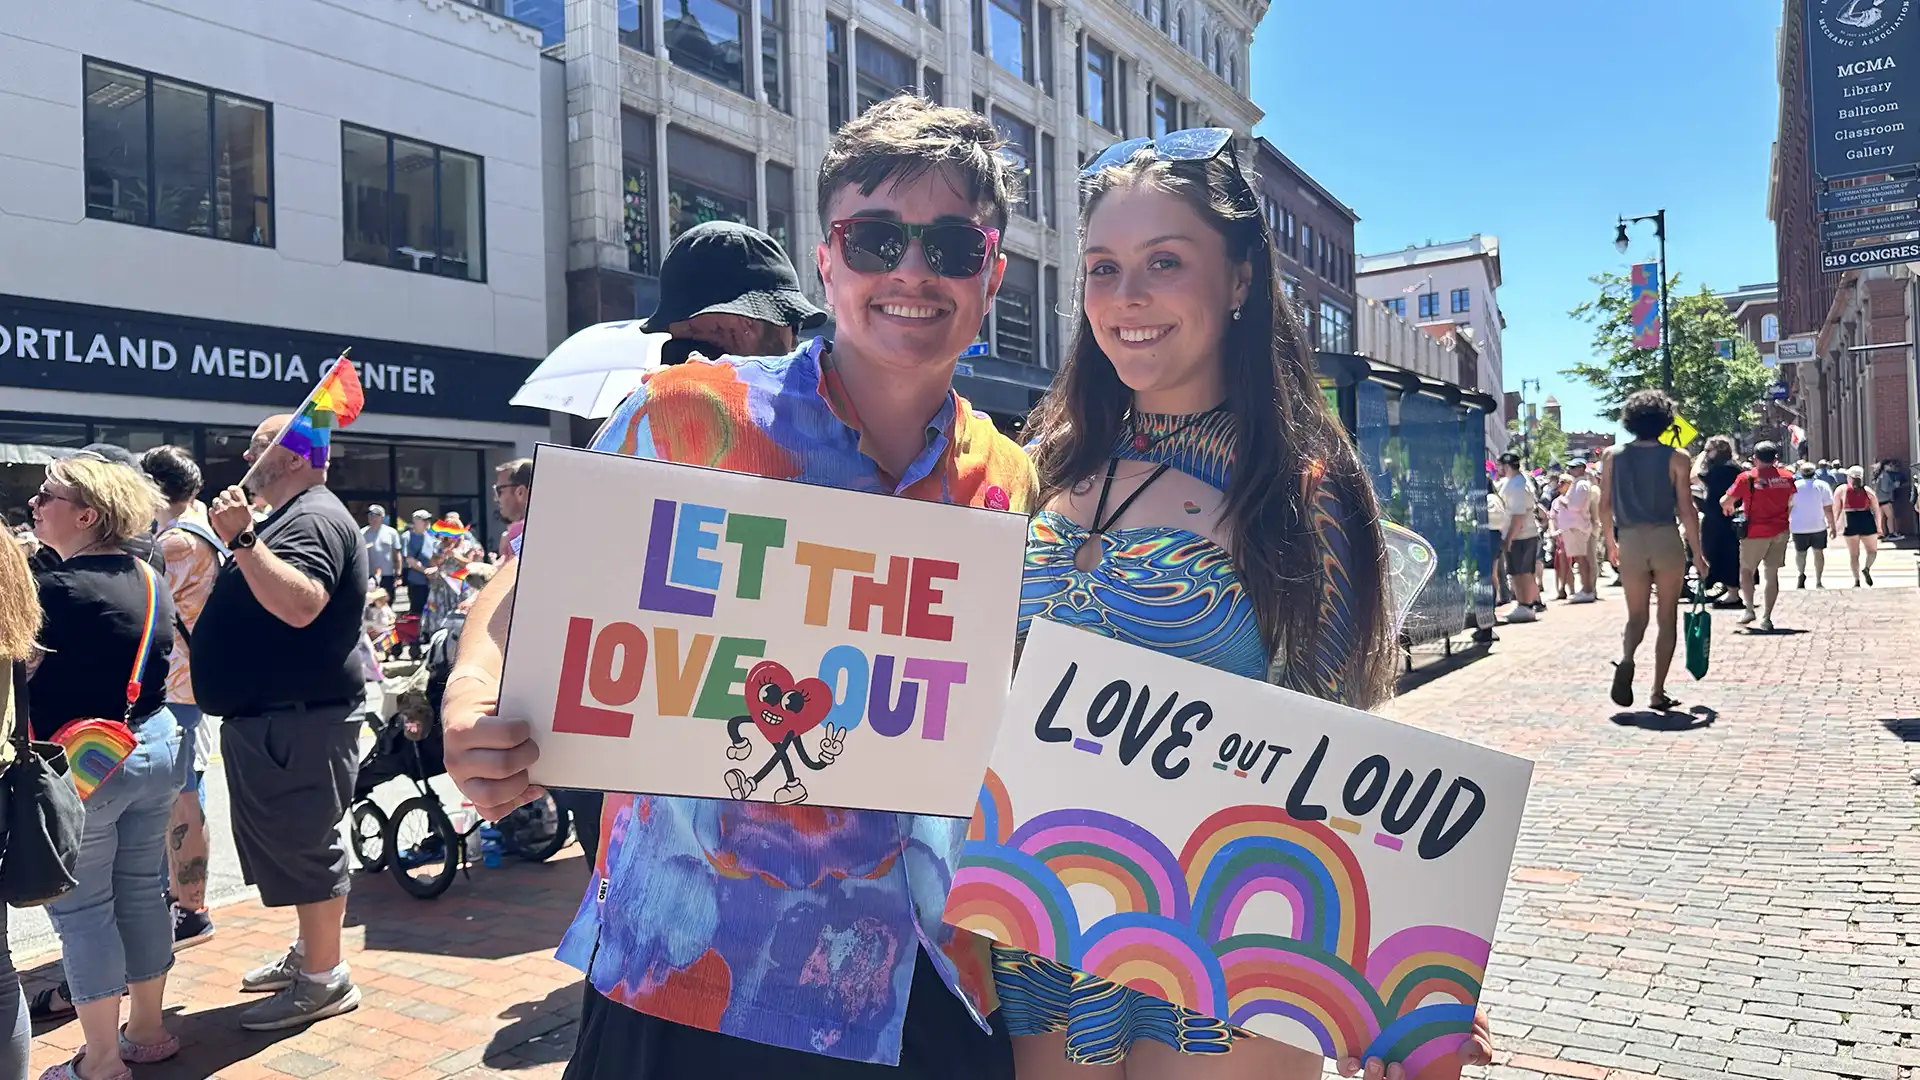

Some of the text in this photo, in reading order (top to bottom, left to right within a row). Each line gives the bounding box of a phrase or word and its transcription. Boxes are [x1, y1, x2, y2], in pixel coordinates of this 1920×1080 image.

[1819, 18, 1854, 47] MECHANIC
[1862, 1, 1910, 46] ASSOCIATION
[1837, 56, 1896, 78] MCMA
[1843, 81, 1892, 98] Library
[1838, 102, 1899, 120] Ballroom
[1834, 122, 1905, 141] Classroom
[1846, 145, 1895, 160] Gallery
[1835, 187, 1879, 197] INTERNATIONAL
[1880, 183, 1899, 191] UNION
[1839, 189, 1905, 201] OPERATING ENGINEERS
[1826, 227, 1870, 237] CONSTRUCTION
[1872, 222, 1895, 230] TRADES
[1876, 216, 1905, 224] BUILDING
[1825, 244, 1920, 267] 519 CONGRES
[190, 345, 309, 384] MEDIA
[639, 498, 960, 642] LET THE
[552, 616, 968, 741] LOVE OUT
[1034, 662, 1487, 860] LOVE OUT LOUD
